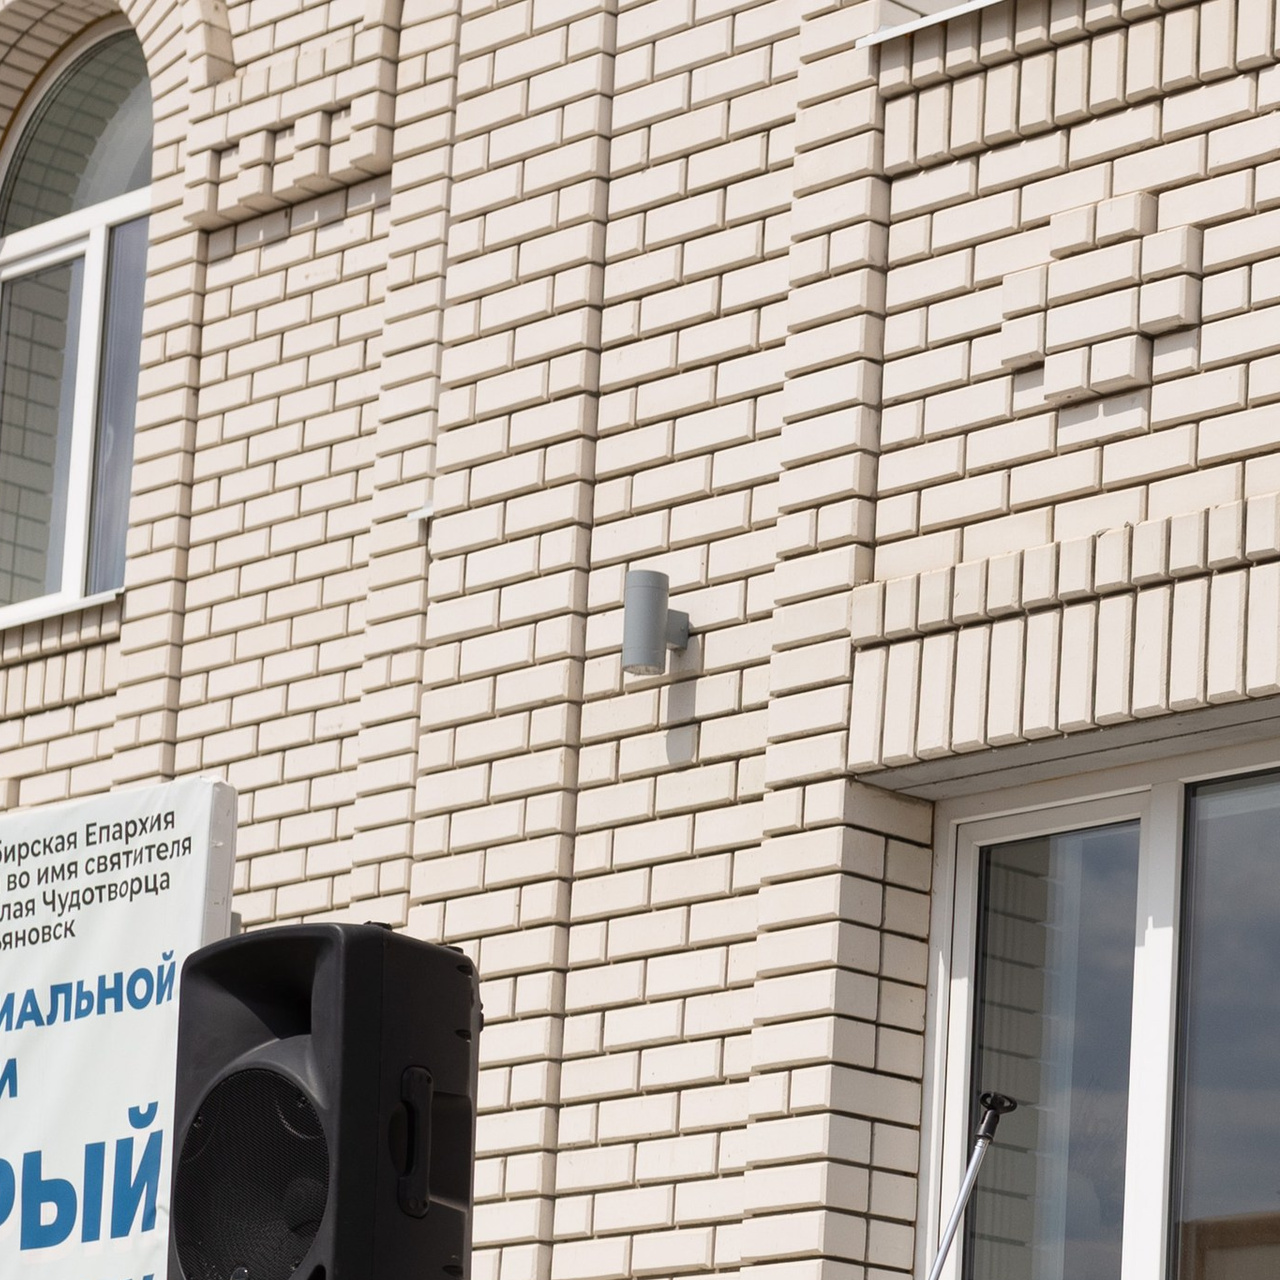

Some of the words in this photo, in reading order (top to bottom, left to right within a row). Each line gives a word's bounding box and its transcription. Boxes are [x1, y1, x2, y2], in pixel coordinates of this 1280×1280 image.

[0, 832, 77, 866] ирская
[85, 810, 175, 846] Епархия
[7, 870, 30, 892] во
[37, 861, 78, 886] имя
[84, 836, 192, 875] святителя
[0, 898, 35, 922] лая
[42, 871, 170, 917] Чудотворца
[0, 919, 76, 950] яновск
